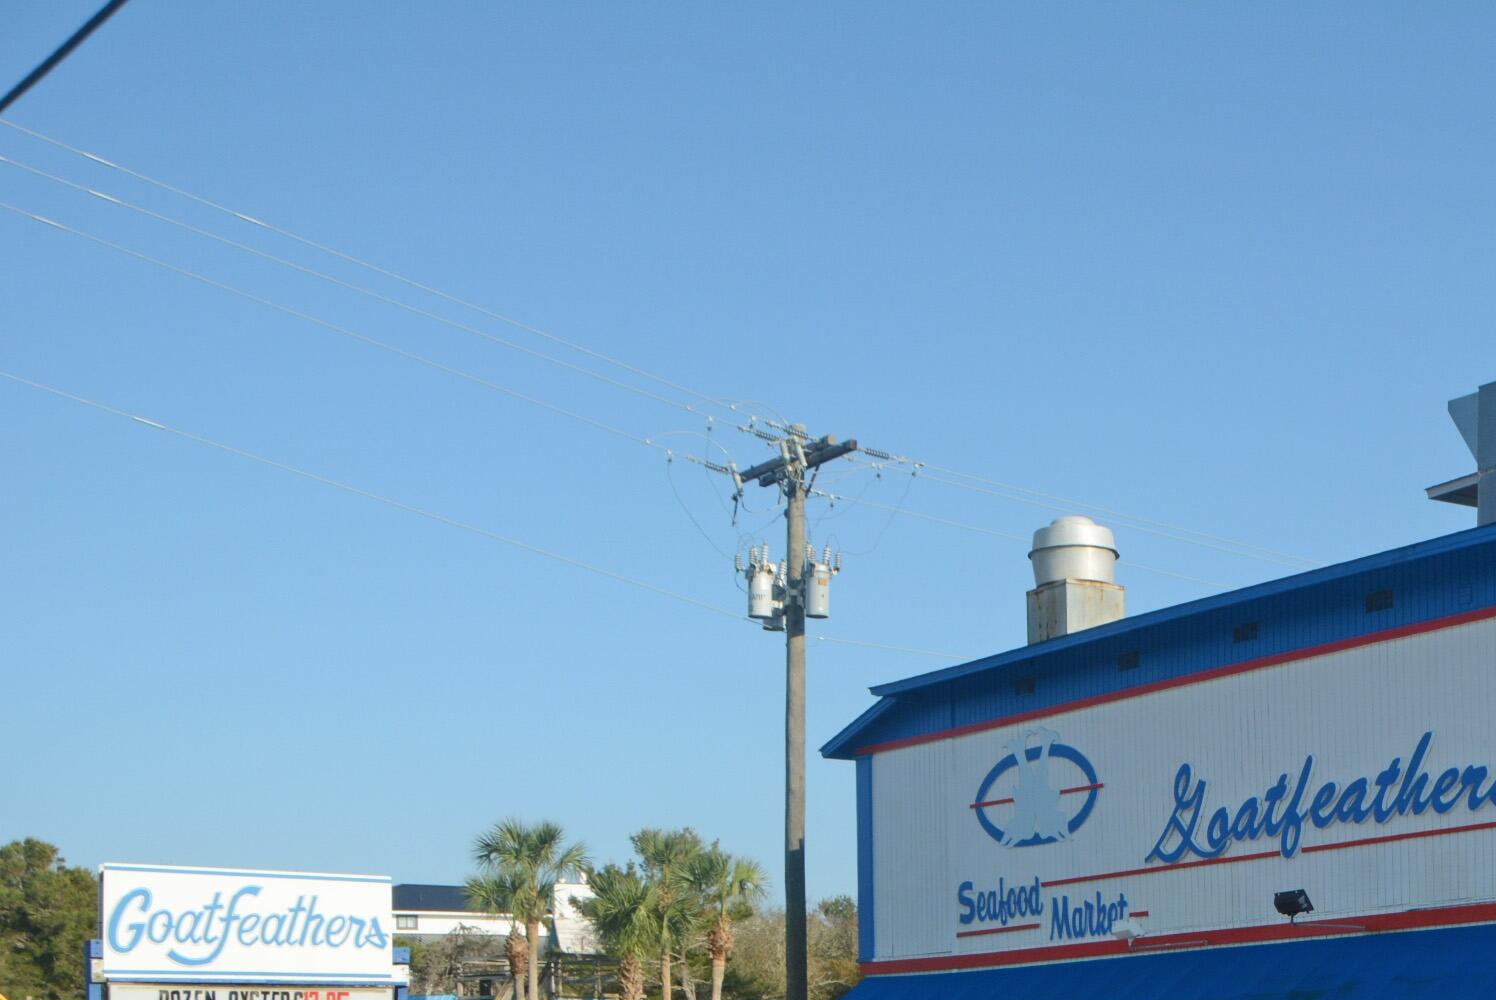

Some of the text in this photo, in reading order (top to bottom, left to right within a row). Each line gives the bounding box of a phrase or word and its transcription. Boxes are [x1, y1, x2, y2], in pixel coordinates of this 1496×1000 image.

[108, 885, 389, 966] Goatfeathers
[957, 876, 1128, 941] Seafood Market
